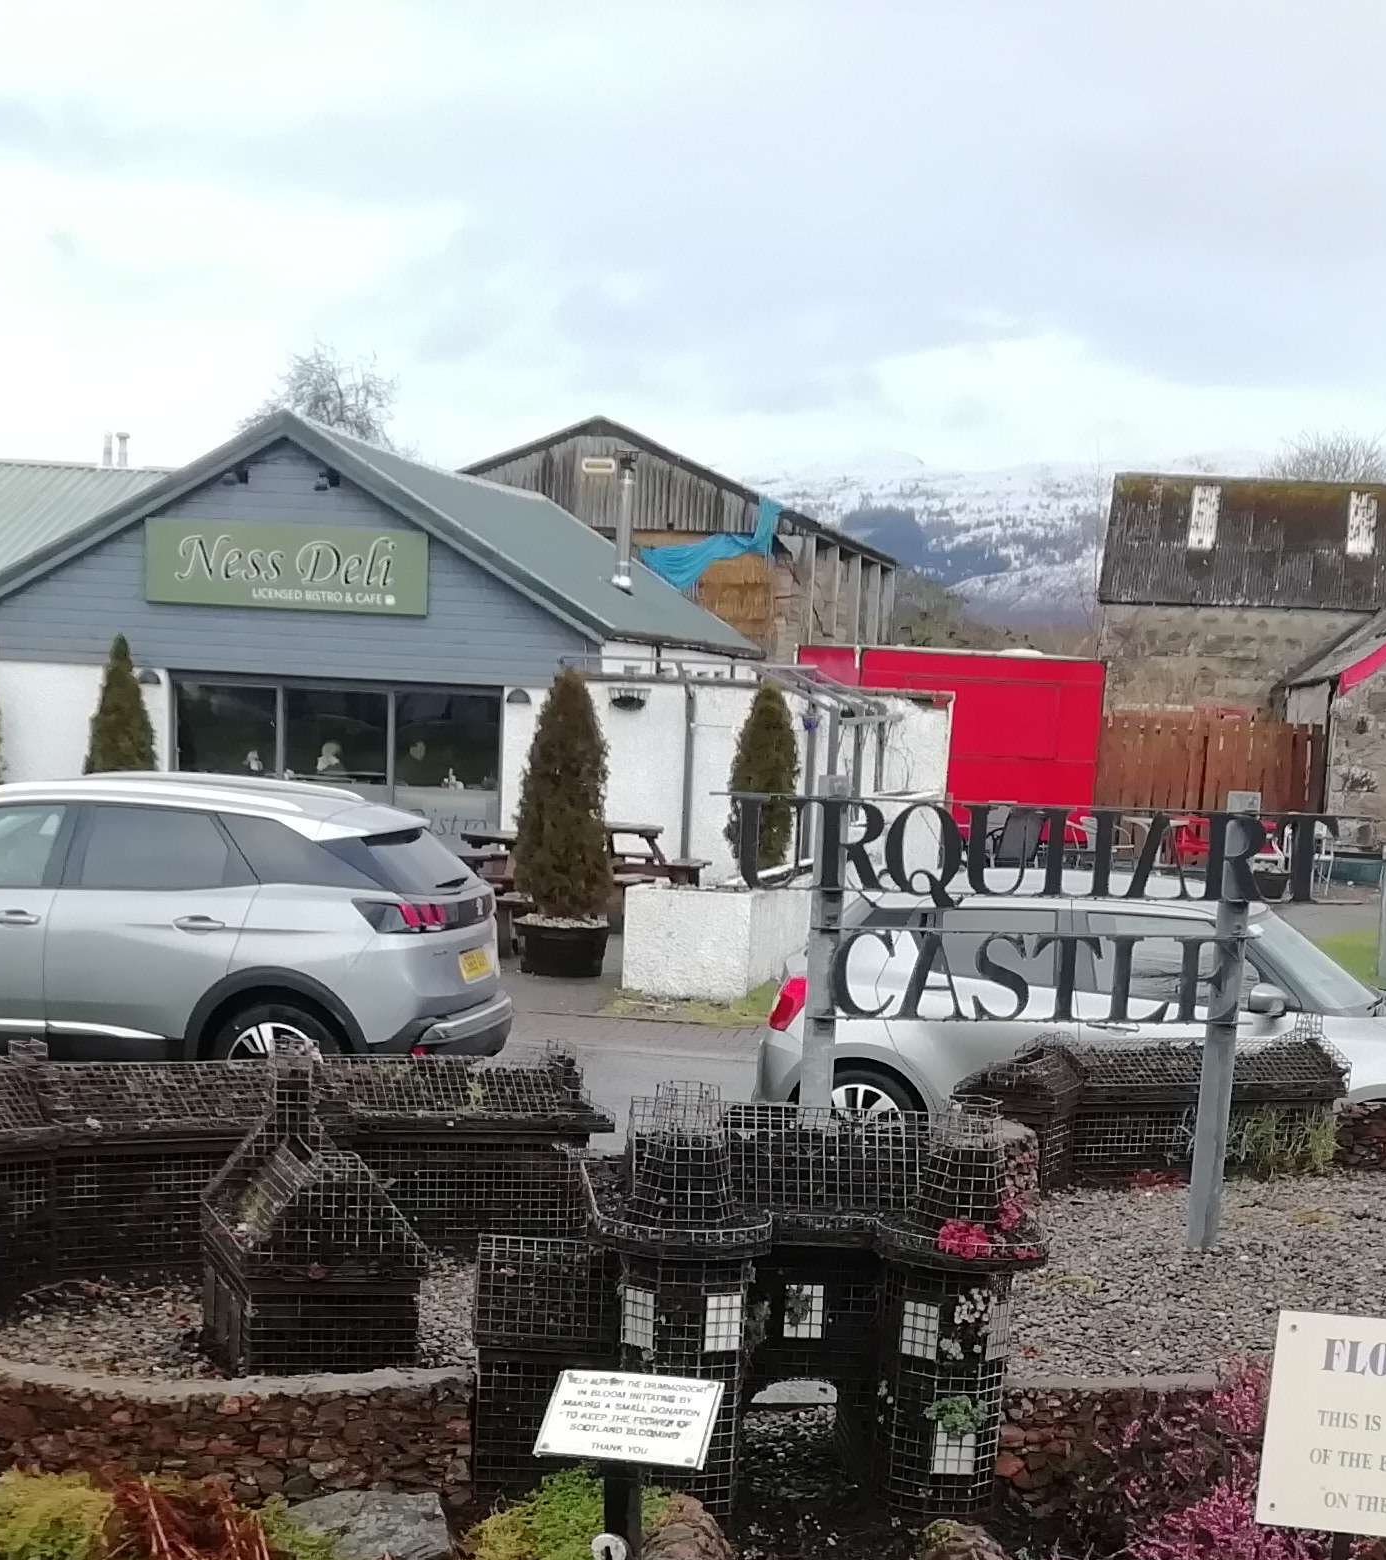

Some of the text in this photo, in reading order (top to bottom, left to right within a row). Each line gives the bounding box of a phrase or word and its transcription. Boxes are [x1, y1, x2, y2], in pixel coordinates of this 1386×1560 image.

[174, 534, 397, 587] Ness Deli
[251, 588, 382, 605] LICENSED BISTRO & CAFE
[739, 798, 1341, 907] URQUHART
[831, 930, 1240, 1023] CASTLE
[590, 1389, 626, 1398] BLOOM
[679, 1396, 693, 1404] BY
[561, 1399, 600, 1409] MAKING
[615, 1402, 647, 1413] SMALL
[650, 1405, 701, 1417] DONATION
[580, 1412, 608, 1421] KEEP
[612, 1414, 630, 1423] THE
[677, 1420, 693, 1429] OF
[1318, 1410, 1358, 1430] THIS
[1365, 1414, 1381, 1432] IS
[569, 1423, 681, 1440] SCOTLAND BLOOMING
[591, 1442, 649, 1455] THANK YOU
[1309, 1447, 1332, 1466] OF
[1338, 1451, 1373, 1470] THE
[1324, 1491, 1348, 1510] ON
